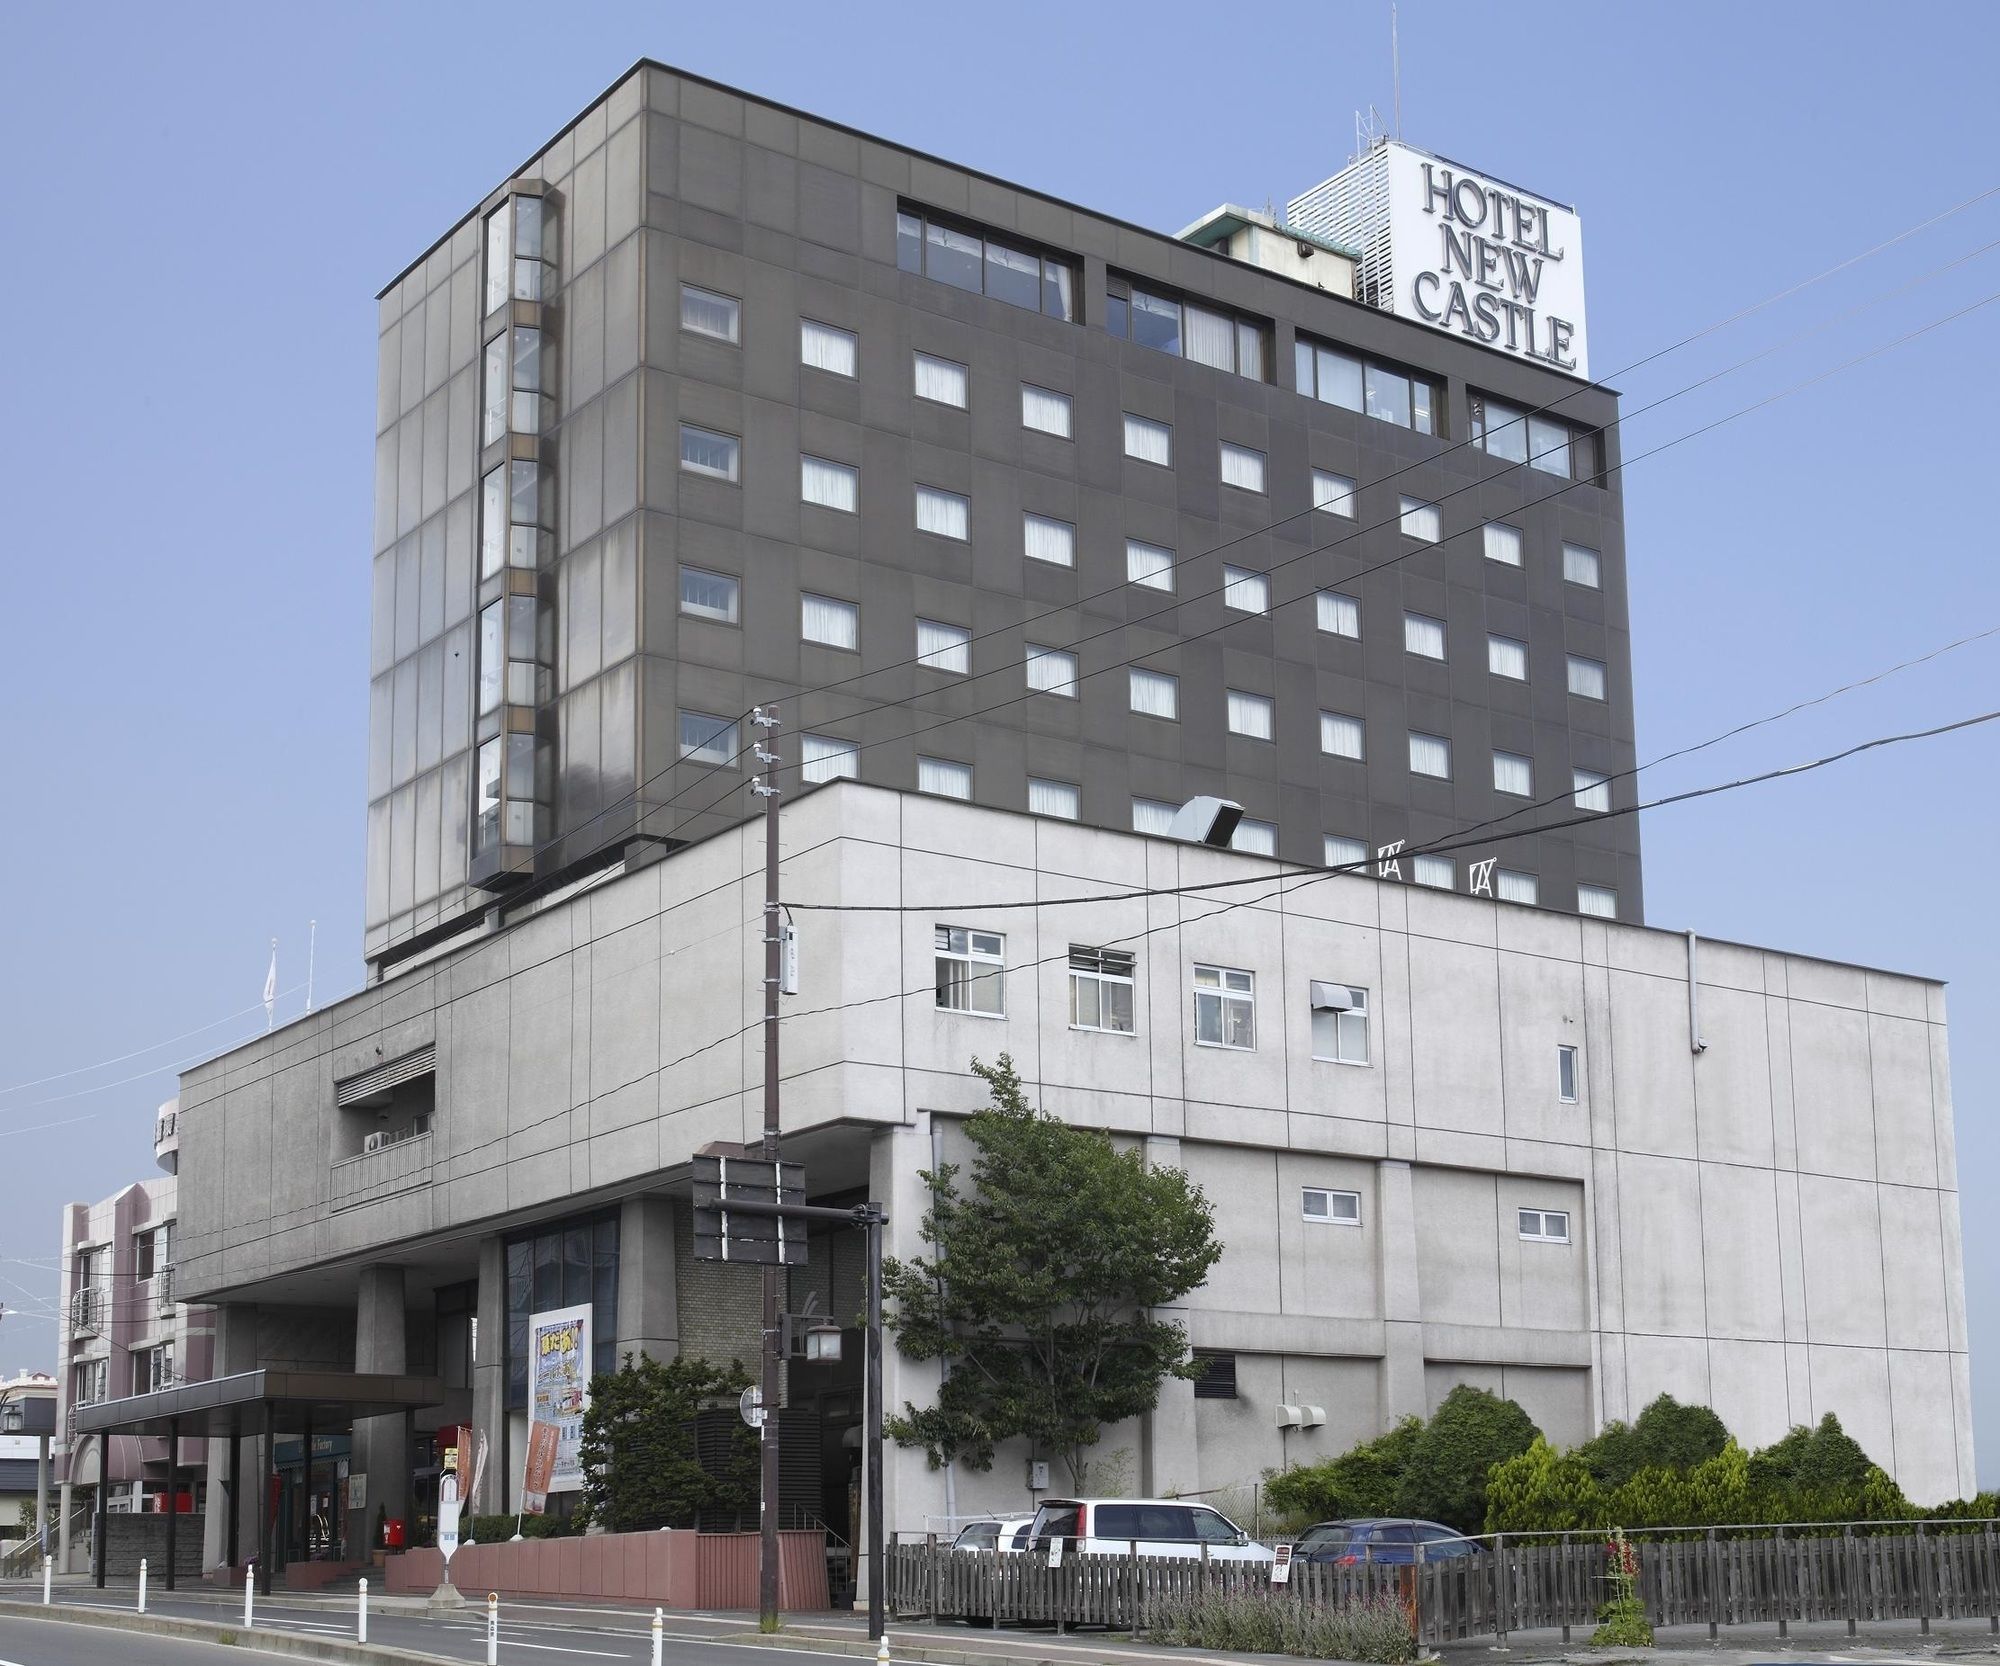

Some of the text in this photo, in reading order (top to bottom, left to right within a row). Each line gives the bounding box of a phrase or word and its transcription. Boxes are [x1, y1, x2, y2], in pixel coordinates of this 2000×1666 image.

[1421, 162, 1564, 262] HOTEL
[1439, 222, 1544, 304] NEW
[1412, 271, 1577, 371] CASTLE
